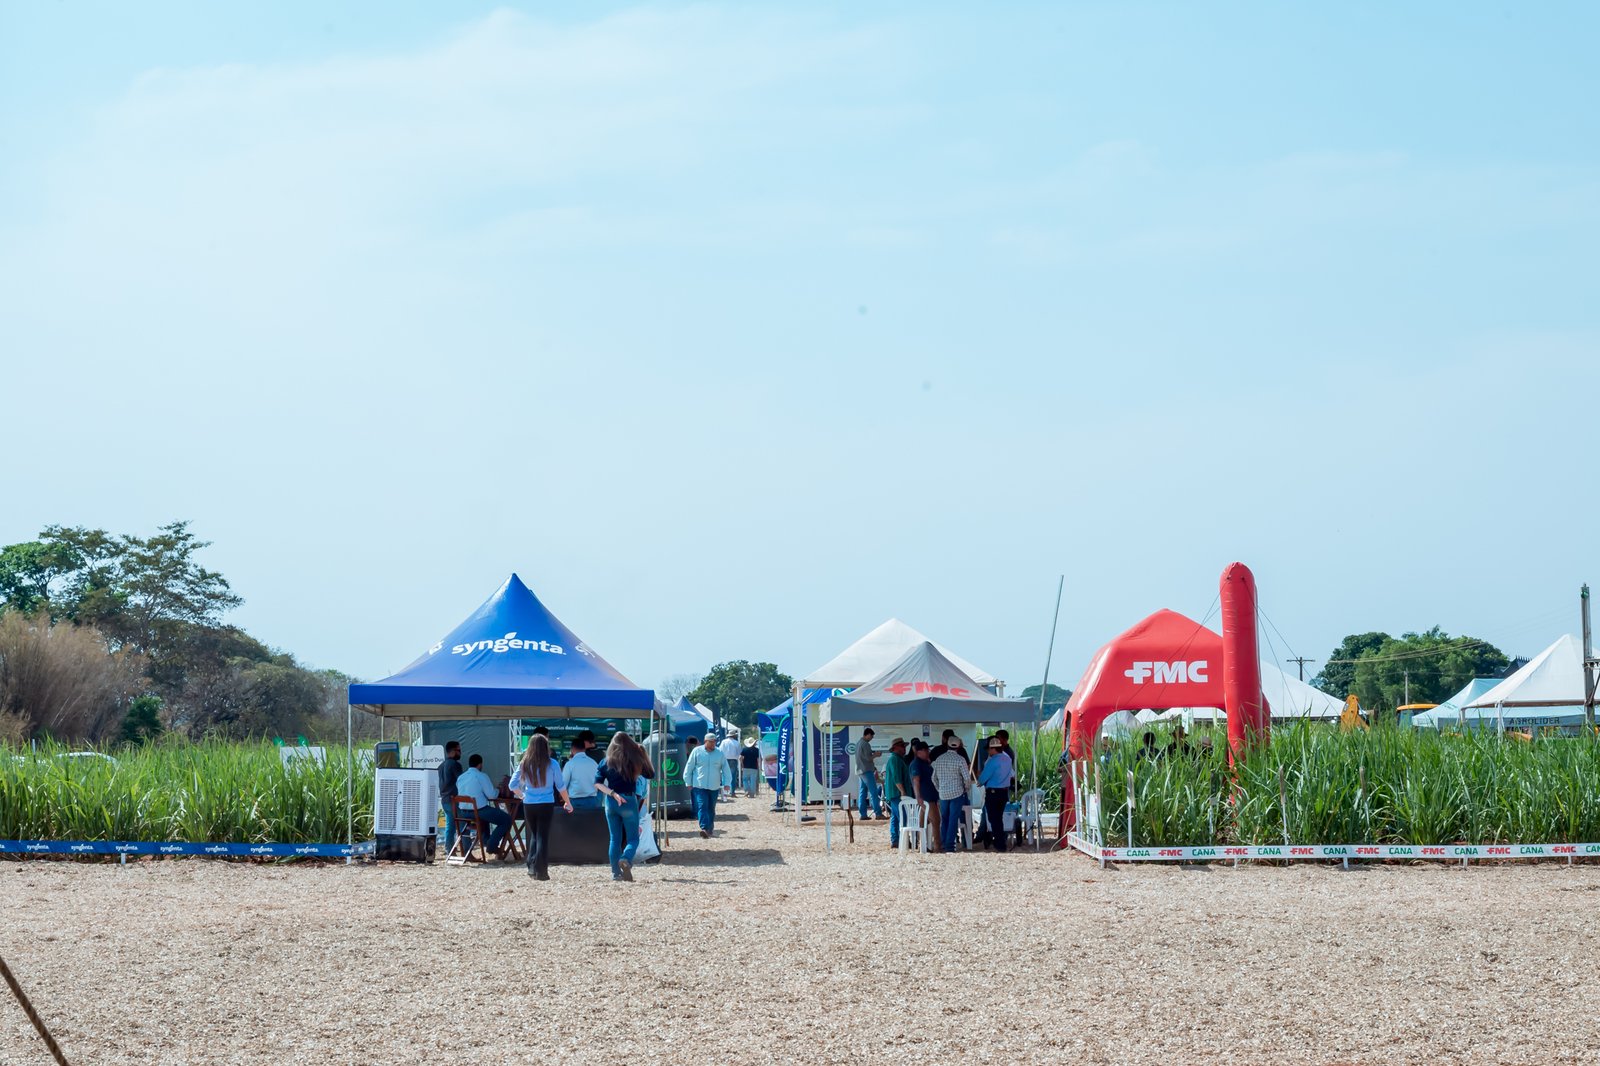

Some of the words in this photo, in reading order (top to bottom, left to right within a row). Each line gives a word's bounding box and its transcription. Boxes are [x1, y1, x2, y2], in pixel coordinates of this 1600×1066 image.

[451, 636, 566, 656] syngenta
[1124, 660, 1208, 684] FMC
[883, 681, 970, 698] FMC
[779, 728, 788, 762] kracht
